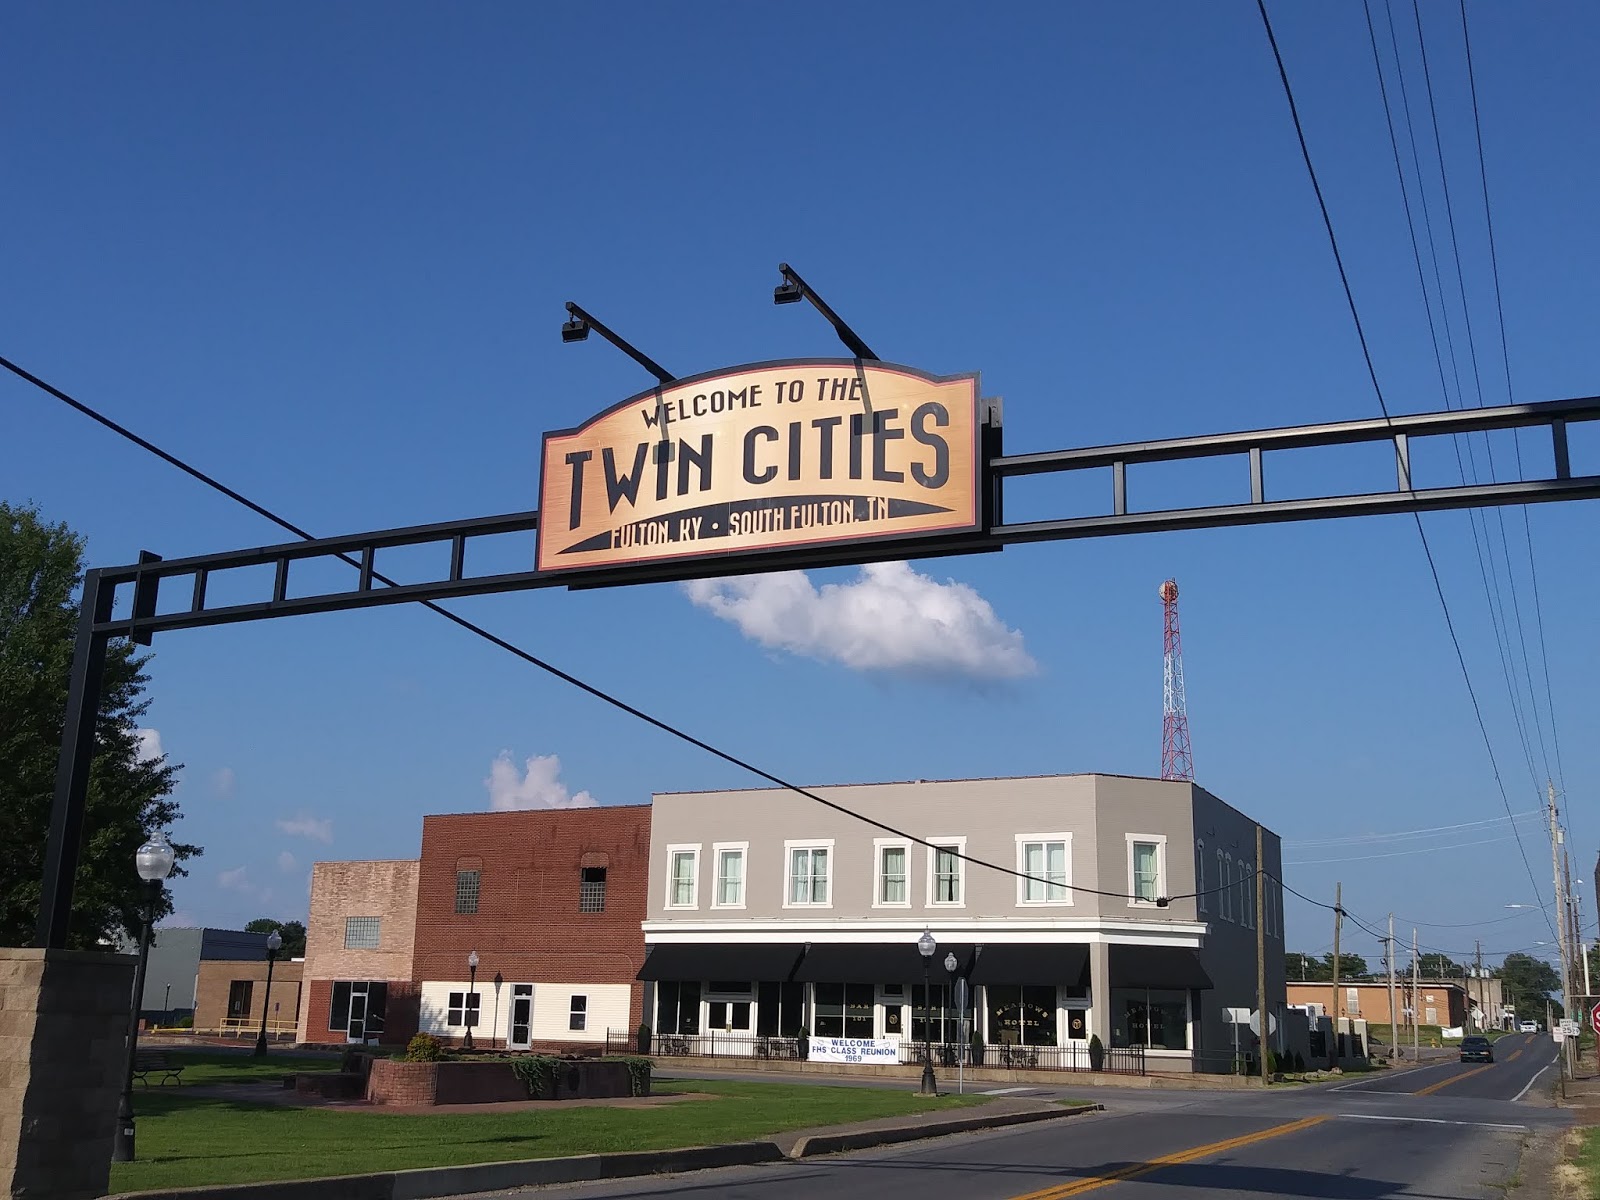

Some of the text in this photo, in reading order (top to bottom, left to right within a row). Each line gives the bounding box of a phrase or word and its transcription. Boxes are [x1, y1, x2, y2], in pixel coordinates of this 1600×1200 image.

[641, 377, 863, 430] WELCOME TO THE
[565, 401, 950, 532] TWIN CITIES
[679, 516, 703, 542] KY
[728, 506, 785, 537] SOUTH
[866, 495, 890, 522] TN
[996, 1002, 1049, 1018] MEADOWS
[812, 1046, 896, 1056] FHS CLASS REUNION
[831, 1039, 876, 1047] WELCOME
[844, 1054, 863, 1062] 1969
